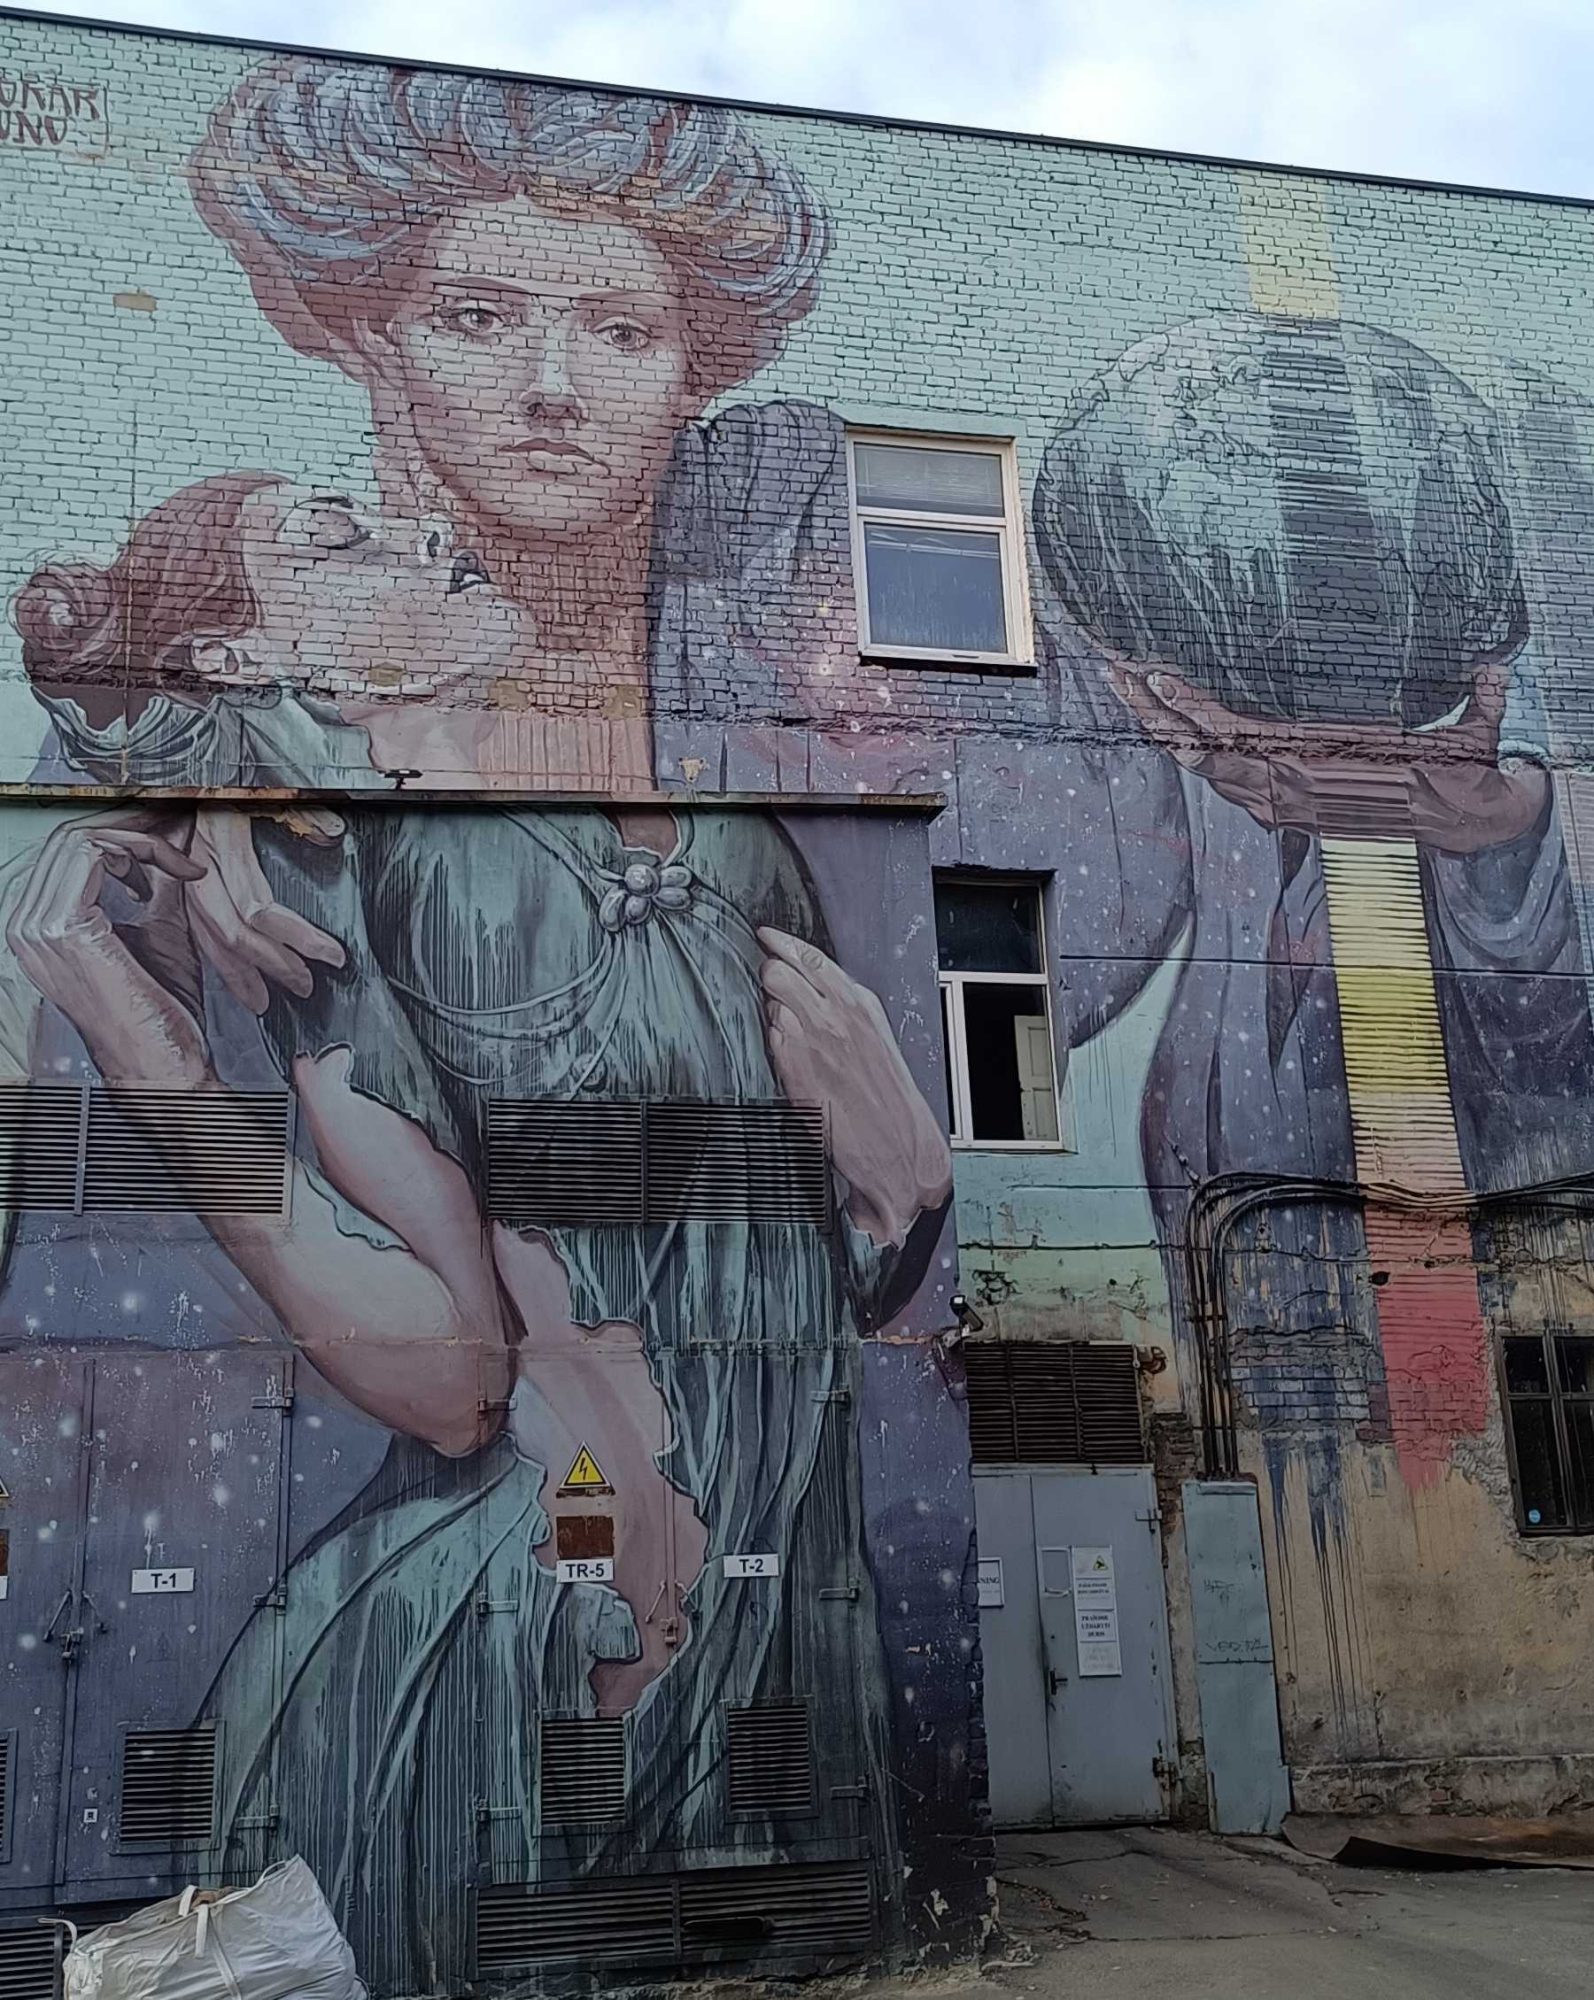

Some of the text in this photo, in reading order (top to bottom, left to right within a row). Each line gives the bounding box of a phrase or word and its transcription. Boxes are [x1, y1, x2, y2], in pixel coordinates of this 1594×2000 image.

[565, 1563, 605, 1578] TR-5
[739, 1558, 764, 1573] T-2
[151, 1573, 177, 1588] T-1
[979, 1576, 1000, 1584] NING
